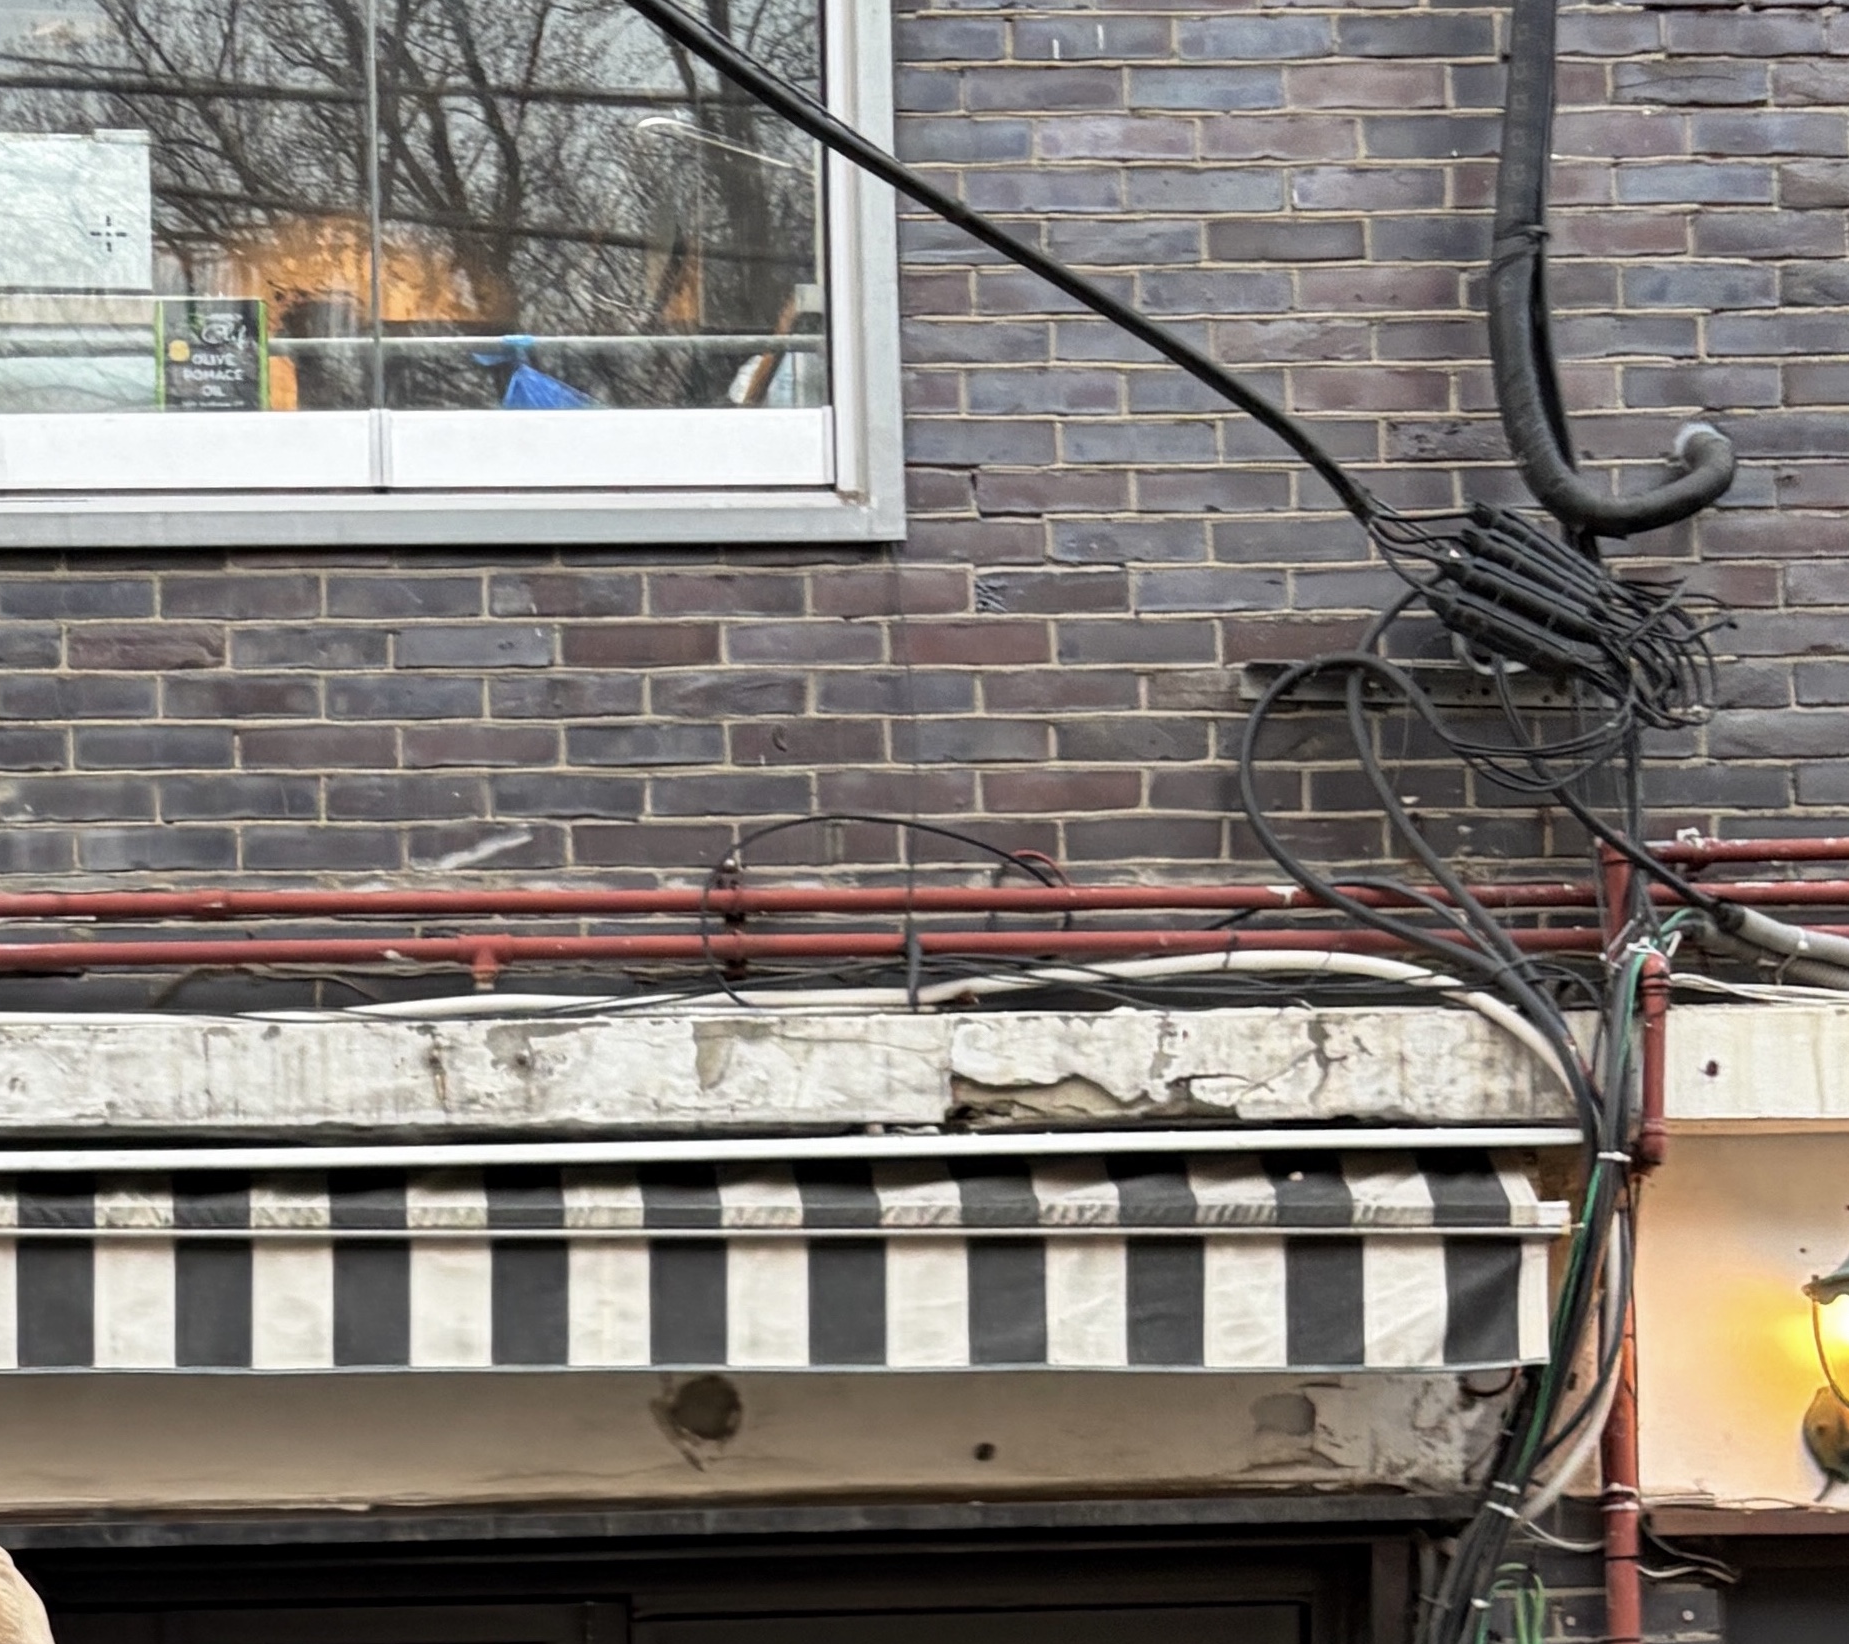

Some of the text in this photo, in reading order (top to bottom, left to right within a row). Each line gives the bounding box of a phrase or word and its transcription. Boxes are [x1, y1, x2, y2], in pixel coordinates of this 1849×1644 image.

[191, 353, 237, 367] OLIVE
[183, 369, 245, 381] POMACE
[201, 385, 226, 397] OIL
